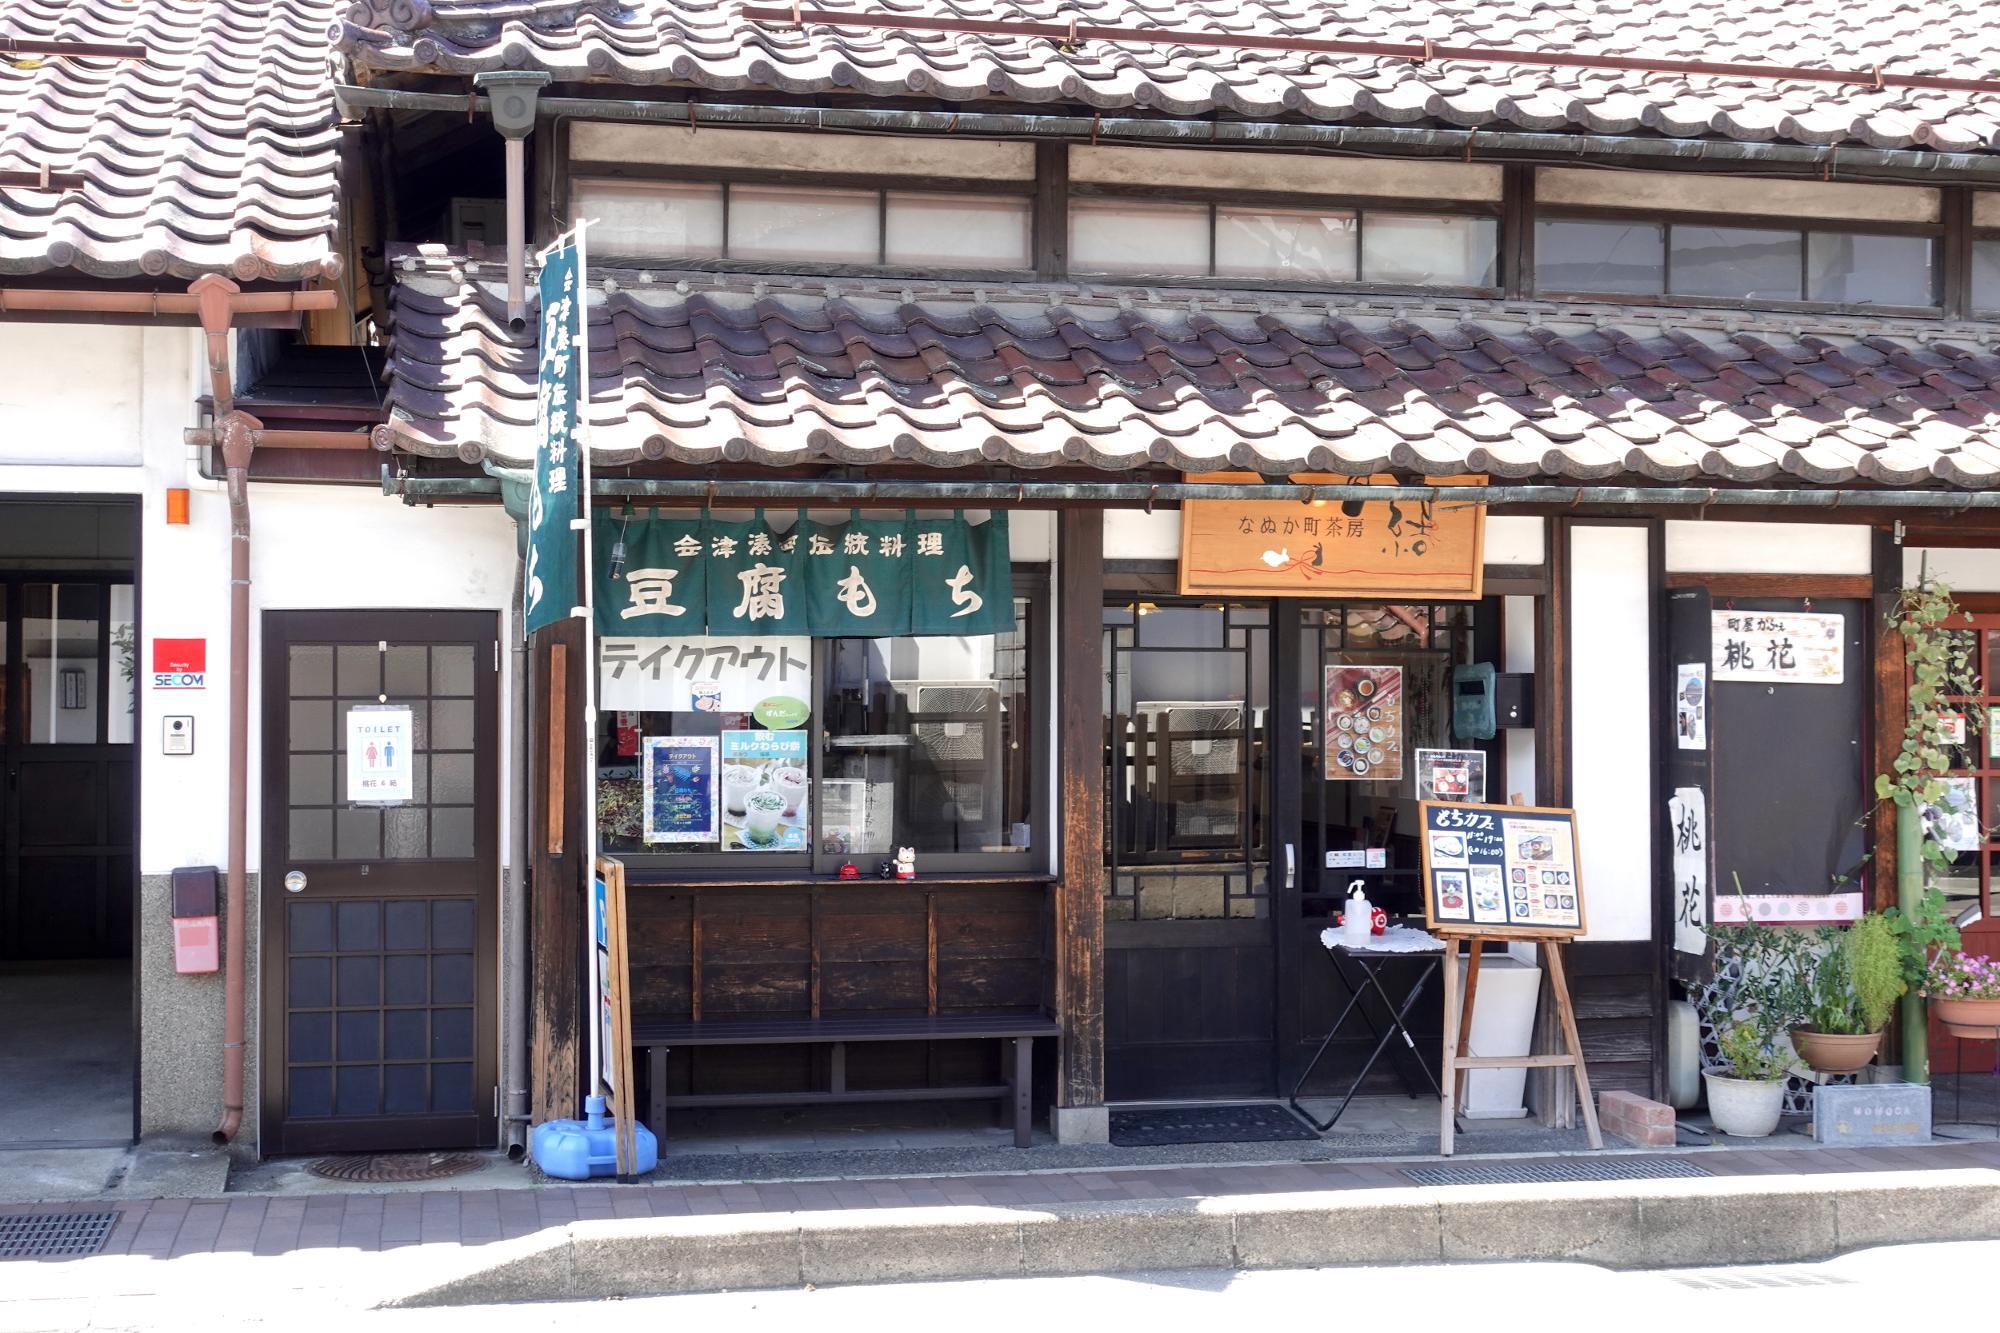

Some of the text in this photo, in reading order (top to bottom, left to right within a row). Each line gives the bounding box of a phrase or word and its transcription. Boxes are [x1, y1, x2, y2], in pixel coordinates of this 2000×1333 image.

[1238, 516, 1365, 538] なぬか町茶房
[673, 531, 945, 559] 会津湊町伝統料理
[620, 562, 983, 621] 豆腐もち
[601, 643, 807, 682] テイクアウト
[1721, 637, 1796, 671] 桃花
[155, 674, 204, 686] SECOM
[357, 725, 401, 734] TOILET
[1676, 803, 1702, 928] 桃花
